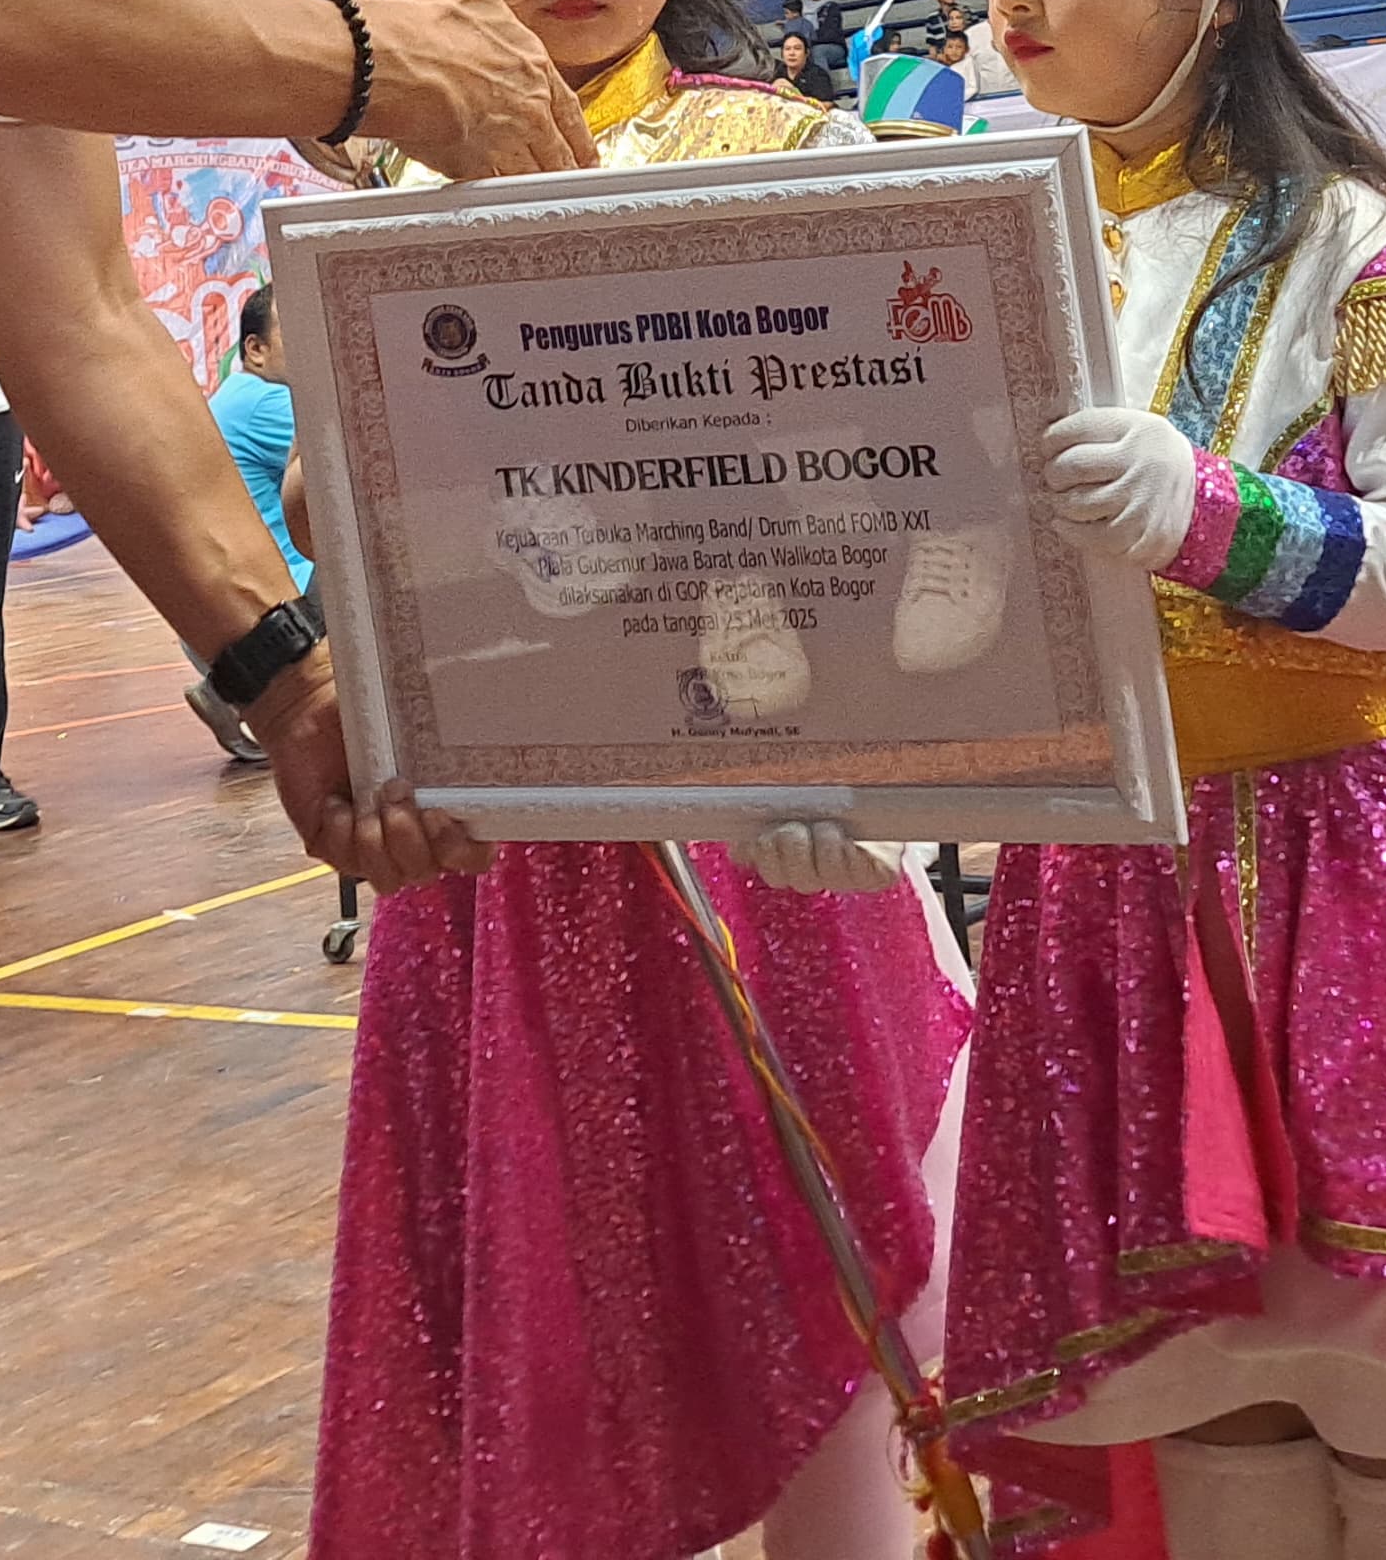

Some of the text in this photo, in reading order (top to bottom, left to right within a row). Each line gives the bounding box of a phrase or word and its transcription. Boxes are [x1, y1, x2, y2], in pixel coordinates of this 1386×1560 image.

[520, 305, 830, 352] Pengurus PDBI Kota Bogor
[483, 347, 928, 410] Tanda Bukti Prestasi
[626, 415, 698, 433] Diberikan
[703, 412, 761, 429] Kepada
[494, 444, 941, 498] TK KINDERFIELD BOGOR
[495, 509, 932, 553] Kejuaraan Terbuka Marching Band/ Drum Band FOMB XXI
[538, 544, 888, 578] Piala Gubernur Jawa Barat dan Walikota Bogor
[558, 586, 654, 606] dilaksanakan
[657, 583, 672, 602] di
[675, 580, 708, 601] GOR
[789, 576, 825, 598] Kota
[829, 575, 876, 601] Bogor
[623, 613, 659, 637] pada
[663, 611, 719, 636] tanggal
[780, 608, 818, 630] 2025
